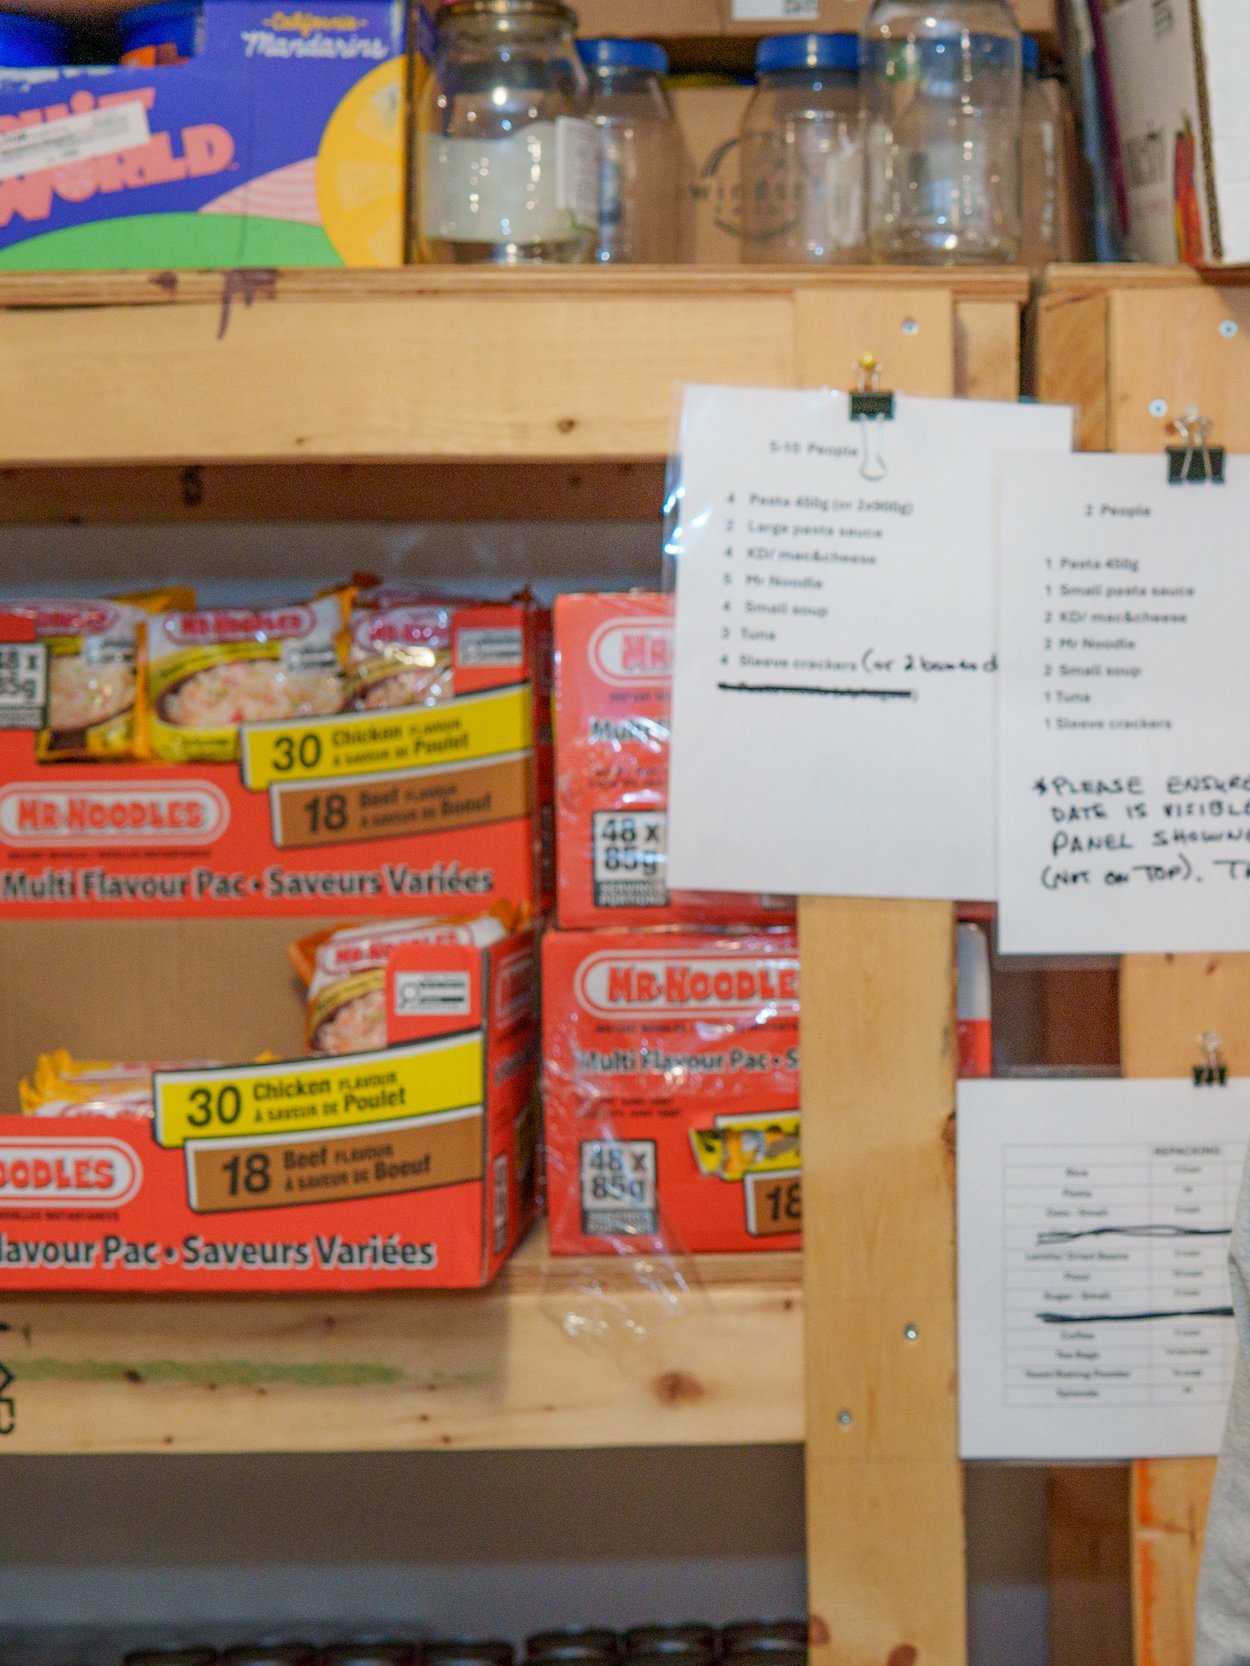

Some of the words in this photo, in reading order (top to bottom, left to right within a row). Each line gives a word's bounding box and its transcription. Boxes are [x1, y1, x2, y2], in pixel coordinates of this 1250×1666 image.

[241, 30, 389, 60] Mandarins
[807, 442, 859, 458] People
[750, 493, 791, 507] Pasta
[1101, 503, 1151, 518] People
[748, 521, 788, 536] Large
[792, 523, 834, 536] pasta
[839, 526, 883, 538] sauce
[778, 549, 877, 564] mac&cheese
[1060, 557, 1100, 570] Pasta
[1105, 558, 1139, 573] 450g
[746, 575, 763, 586] Mr
[768, 576, 823, 589] Noodle
[1060, 584, 1103, 597] Small
[1106, 585, 1147, 598] pasta
[1152, 585, 1195, 597] sauce
[745, 602, 788, 615] Small
[792, 604, 829, 617] soup
[1091, 610, 1187, 624] mac&cheese
[740, 627, 776, 641] Tuna
[1059, 638, 1077, 650] Mr
[1082, 637, 1135, 650] Noodle
[739, 654, 789, 668] Sleeve
[792, 657, 857, 671] crackers
[1059, 664, 1102, 677] Small
[1106, 666, 1142, 679] soup
[1056, 690, 1091, 703] Tuna
[1056, 716, 1104, 730] Sleeve
[1108, 717, 1172, 730] crackers
[273, 734, 322, 771] 30
[332, 726, 402, 746] Chicken
[414, 733, 470, 755] Poulet
[67, 798, 204, 829] NOODLES
[304, 793, 349, 833] 18
[360, 788, 400, 809] Beef
[1051, 804, 1109, 822] DATE
[1127, 804, 1147, 819] IS
[602, 819, 637, 843] 48
[1052, 831, 1134, 856] PANEL
[2, 870, 74, 898] Multi
[82, 870, 188, 898] Flavour
[196, 870, 245, 898] Pac
[265, 867, 382, 898] Saveurs
[388, 860, 494, 896] Variées
[1041, 865, 1090, 889] (NOT
[1104, 870, 1130, 885] ON
[664, 966, 797, 1002] NOODLE
[577, 1050, 637, 1072] Multi
[640, 1048, 723, 1073] Flavour
[730, 1048, 770, 1071] Pac
[187, 1085, 242, 1127] 30
[253, 1077, 332, 1101] Chicken
[338, 1071, 398, 1091] FLAVOUR
[267, 1103, 319, 1122] SAVEUR
[323, 1100, 339, 1115] DE
[343, 1087, 407, 1114] Poulet
[0, 1159, 114, 1188] ODLES
[222, 1152, 272, 1197] 18
[283, 1146, 329, 1170] Beef
[334, 1143, 394, 1164] FLAVOUR
[0, 1233, 94, 1263] lavour
[103, 1236, 156, 1264] Pac
[183, 1236, 309, 1265] Saveurs
[315, 1233, 434, 1265] Variées
